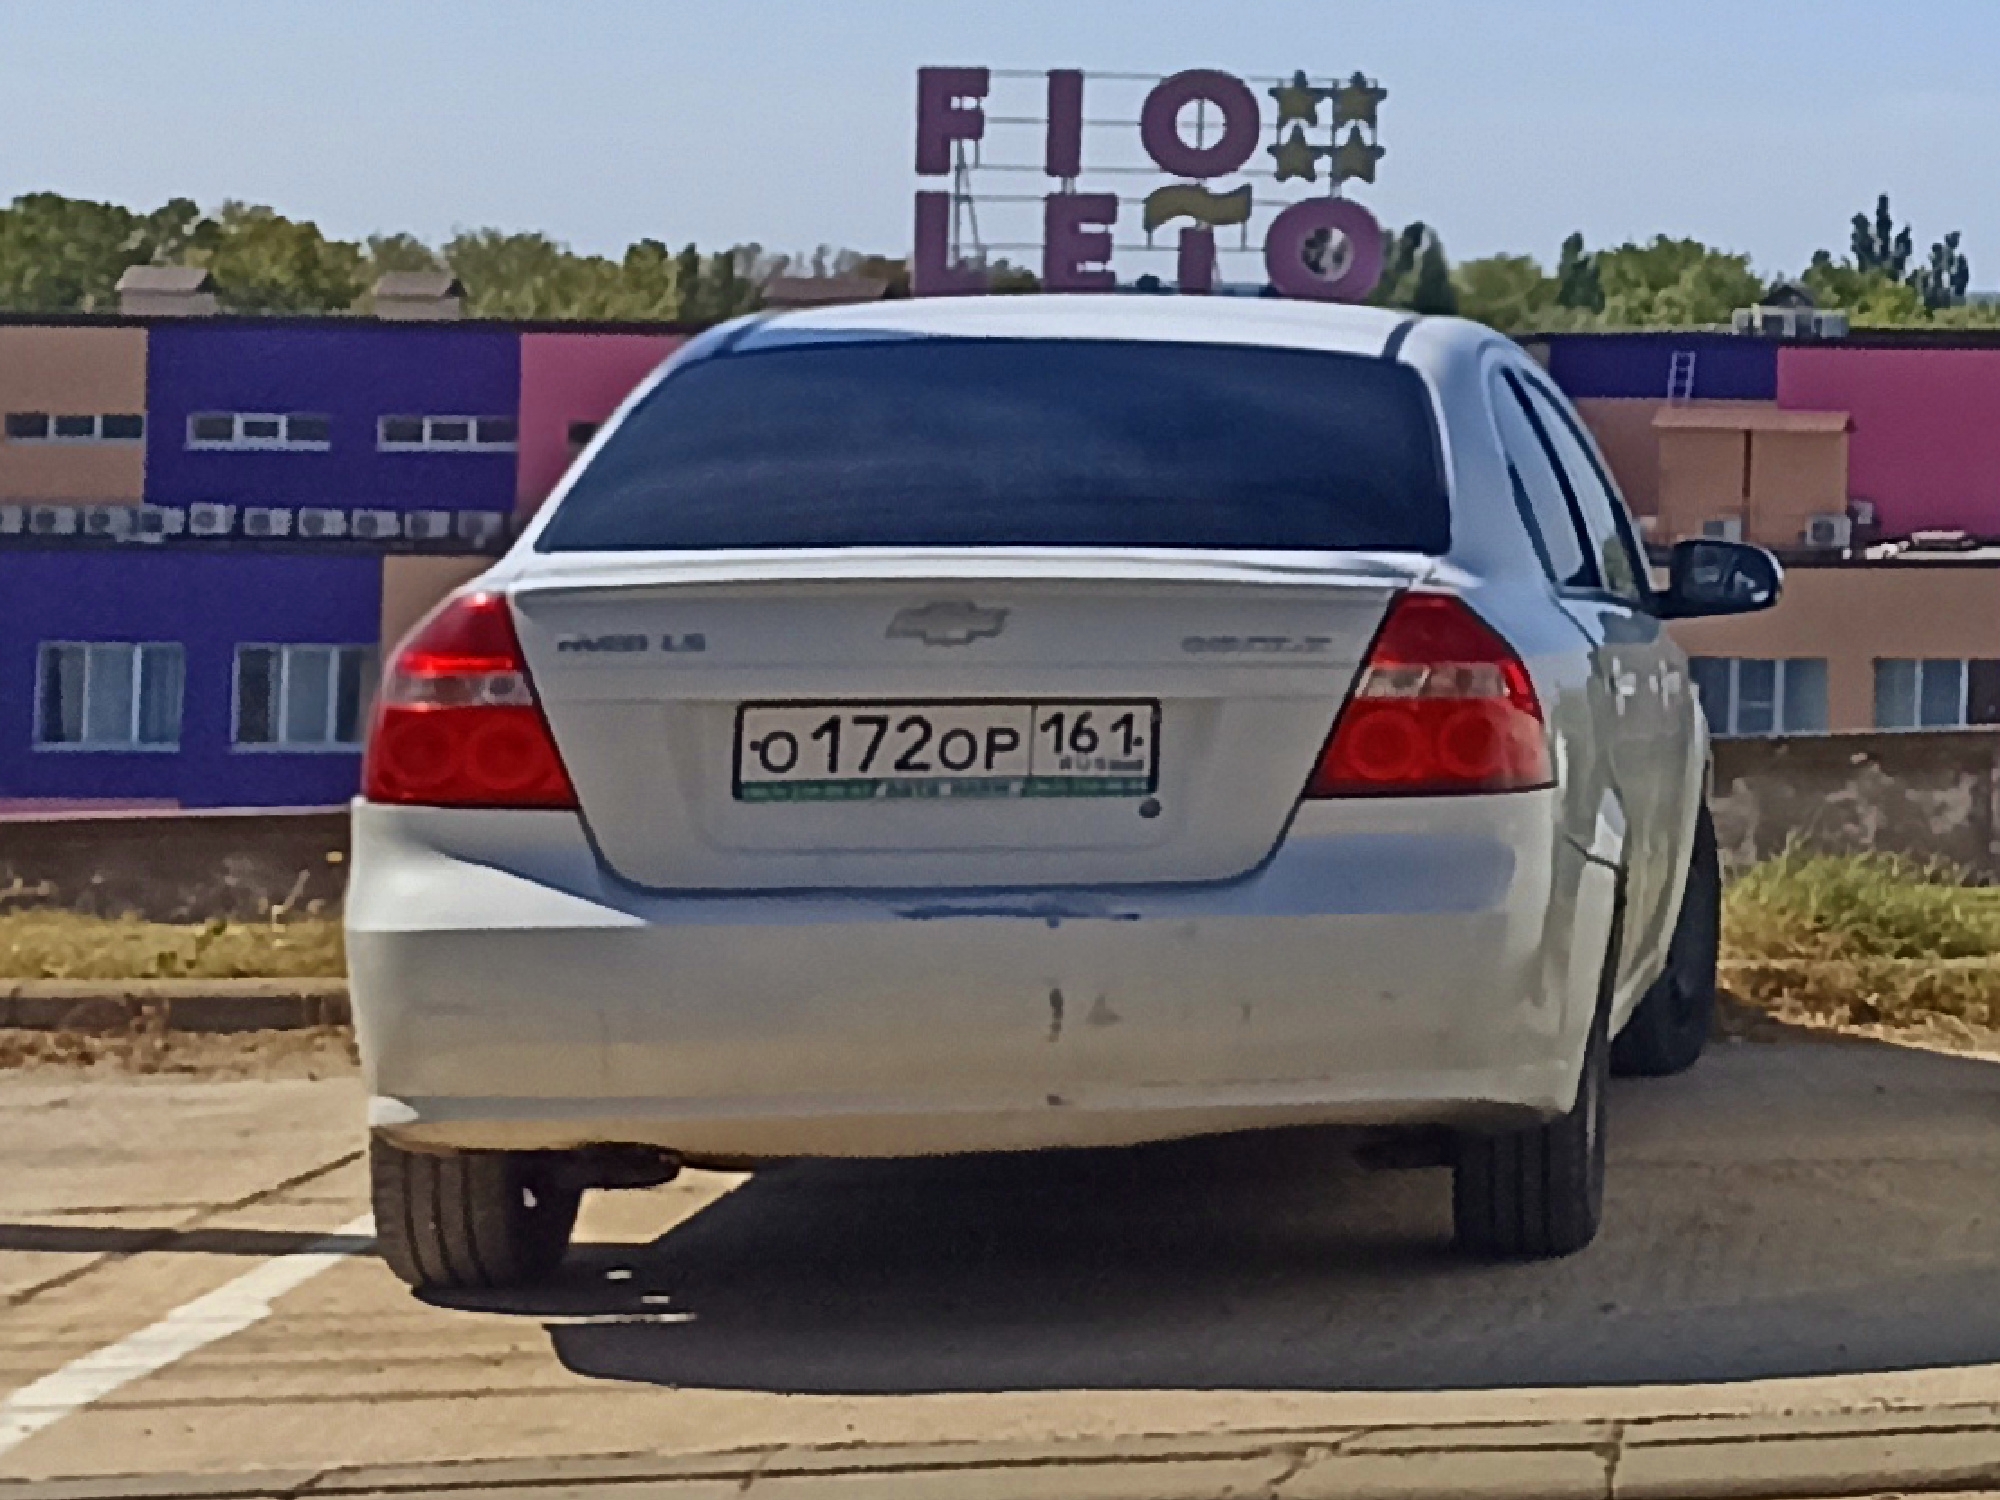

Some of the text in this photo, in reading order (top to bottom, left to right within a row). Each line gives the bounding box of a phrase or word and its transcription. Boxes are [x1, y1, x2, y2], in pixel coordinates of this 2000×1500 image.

[916, 67, 1260, 178] FIO
[759, 711, 1134, 773] O172OP 161
